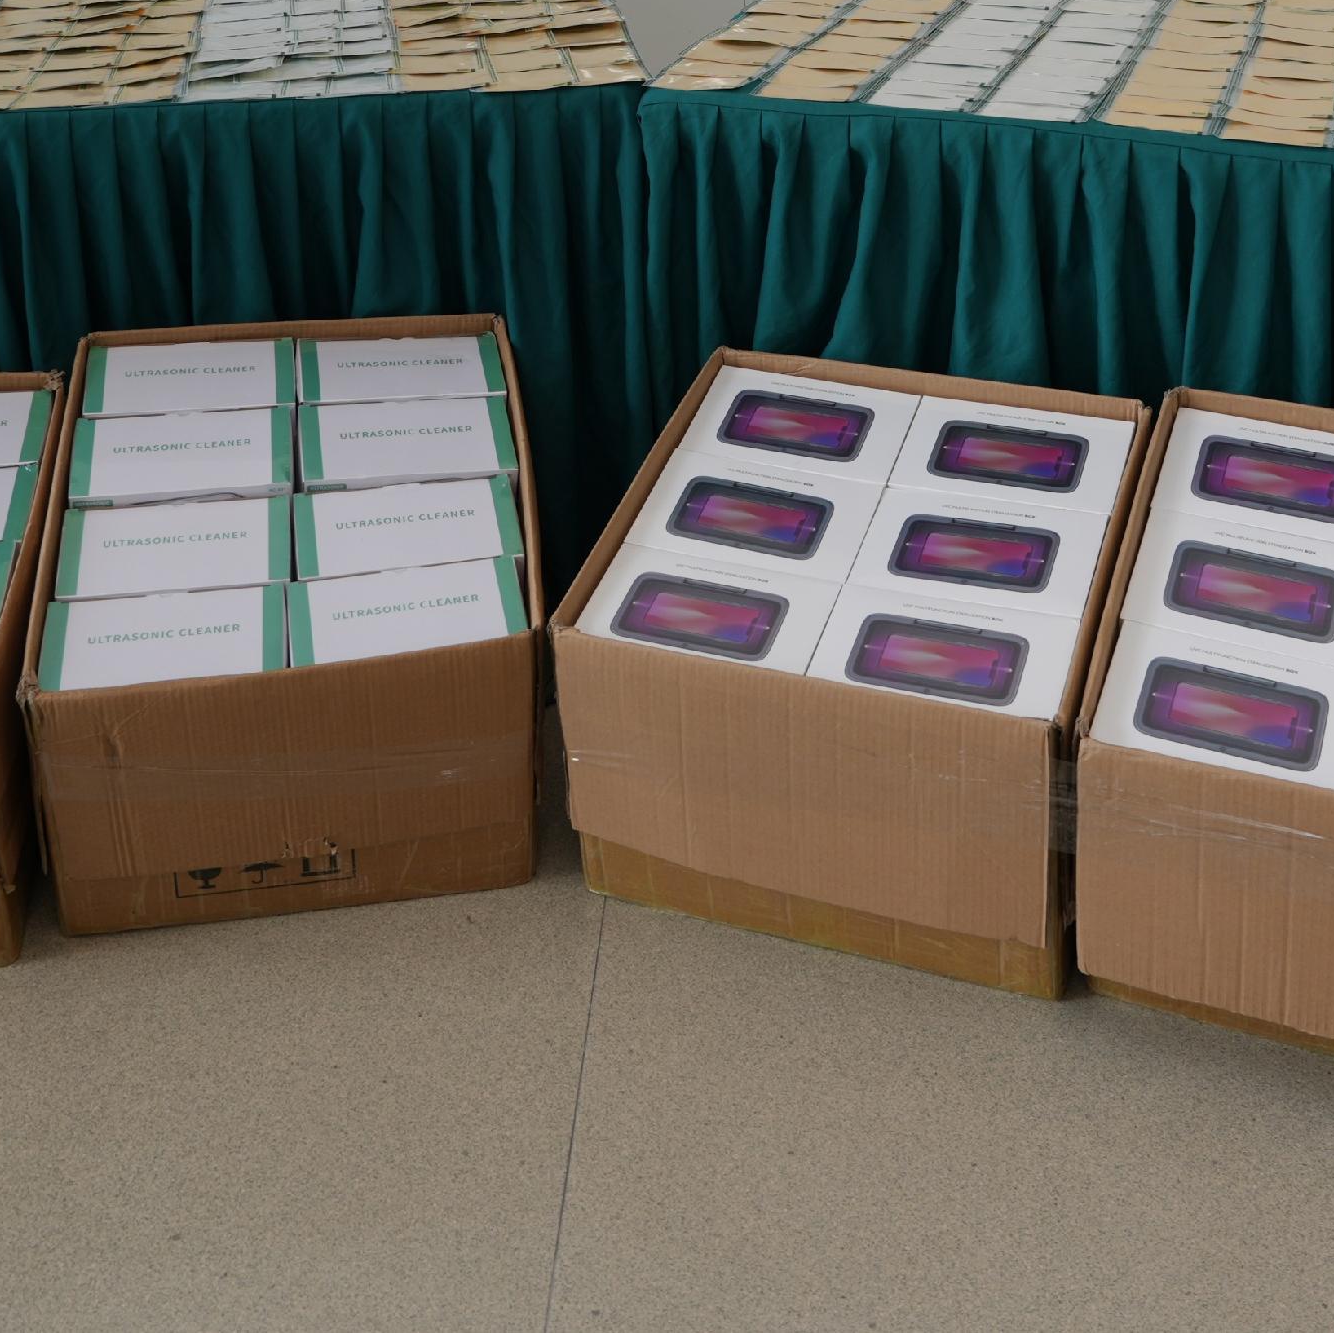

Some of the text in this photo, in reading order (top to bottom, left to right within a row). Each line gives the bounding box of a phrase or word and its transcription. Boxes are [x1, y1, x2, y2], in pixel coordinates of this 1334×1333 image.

[337, 355, 464, 369] ULTRASONIC CLEANER
[124, 365, 256, 378] ULTRASONIC CLEANER
[339, 425, 473, 440] ULTRASONIC CLEANER
[112, 437, 251, 454] ULTRASONIC CLEANER
[335, 508, 475, 530] ULTRASONIC CLEANER
[103, 530, 248, 549] ULTRASONIC CLEANER
[332, 593, 480, 621] ULTRASONIC CLEANER
[87, 623, 241, 645] ULTRASONIC CLEANER
